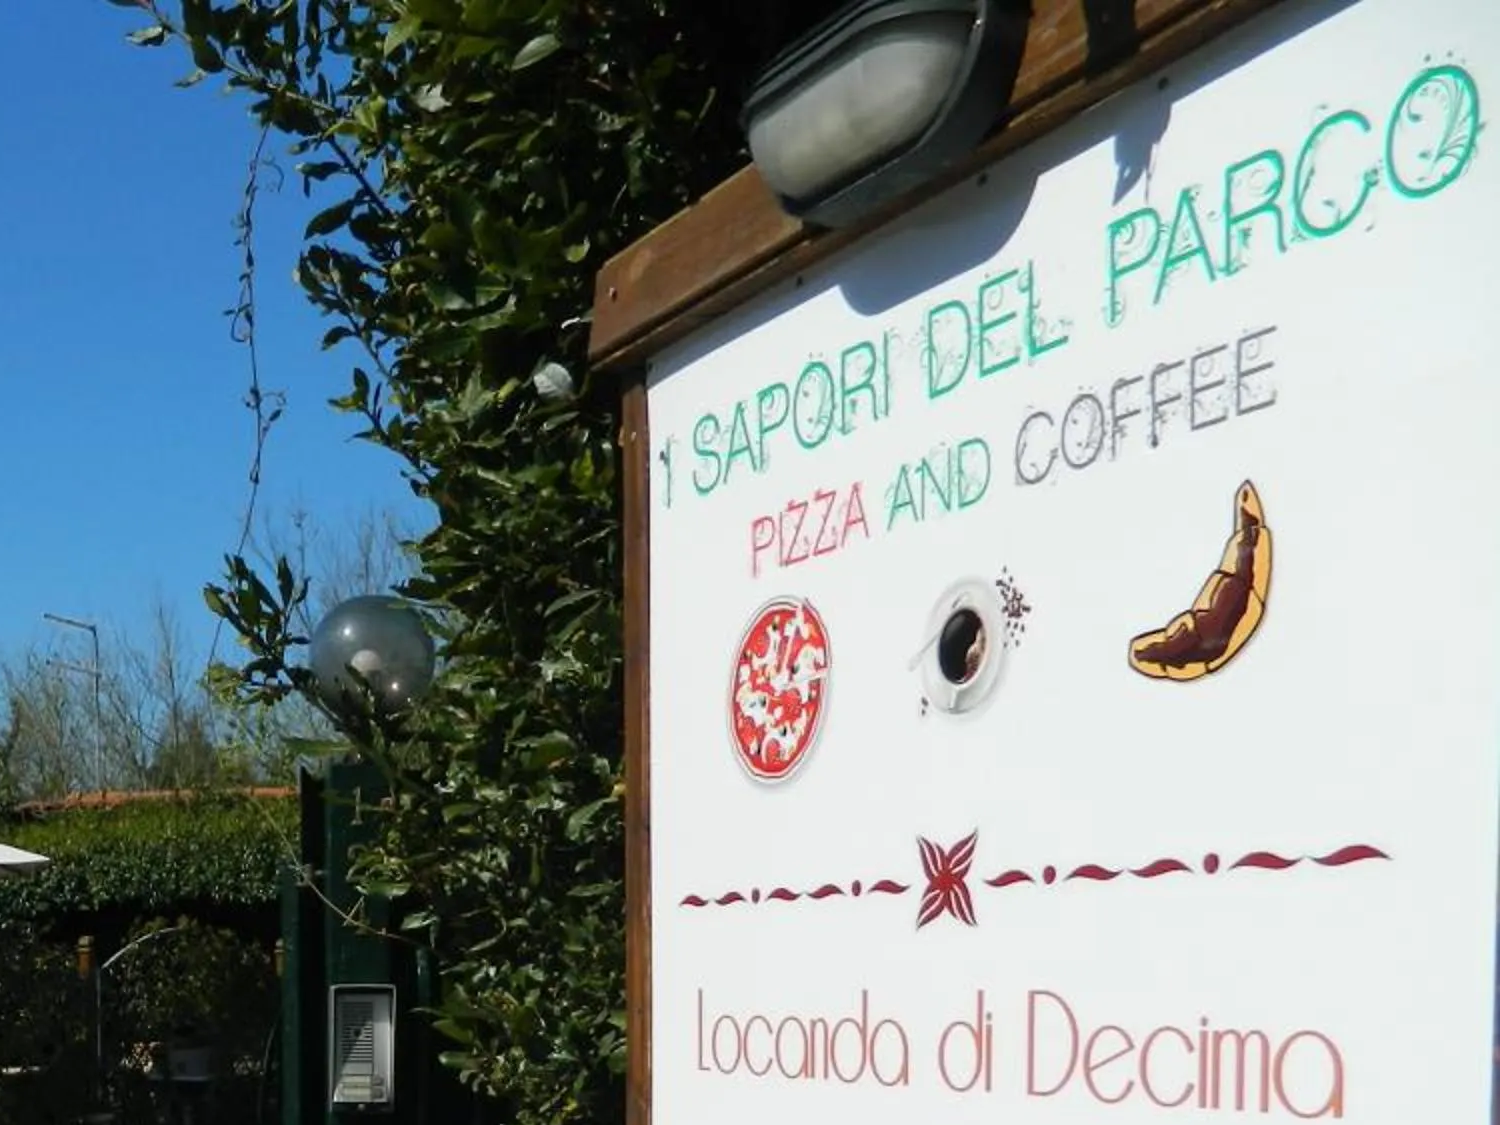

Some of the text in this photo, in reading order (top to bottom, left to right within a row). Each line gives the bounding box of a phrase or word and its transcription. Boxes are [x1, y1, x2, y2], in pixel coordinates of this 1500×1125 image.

[692, 330, 893, 496] SAPORI
[924, 259, 1070, 400] DEL
[1104, 60, 1484, 327] PARCO
[750, 325, 1279, 578] PIZZA AND COFFEE
[696, 987, 1345, 1119] Locanda di Decima
